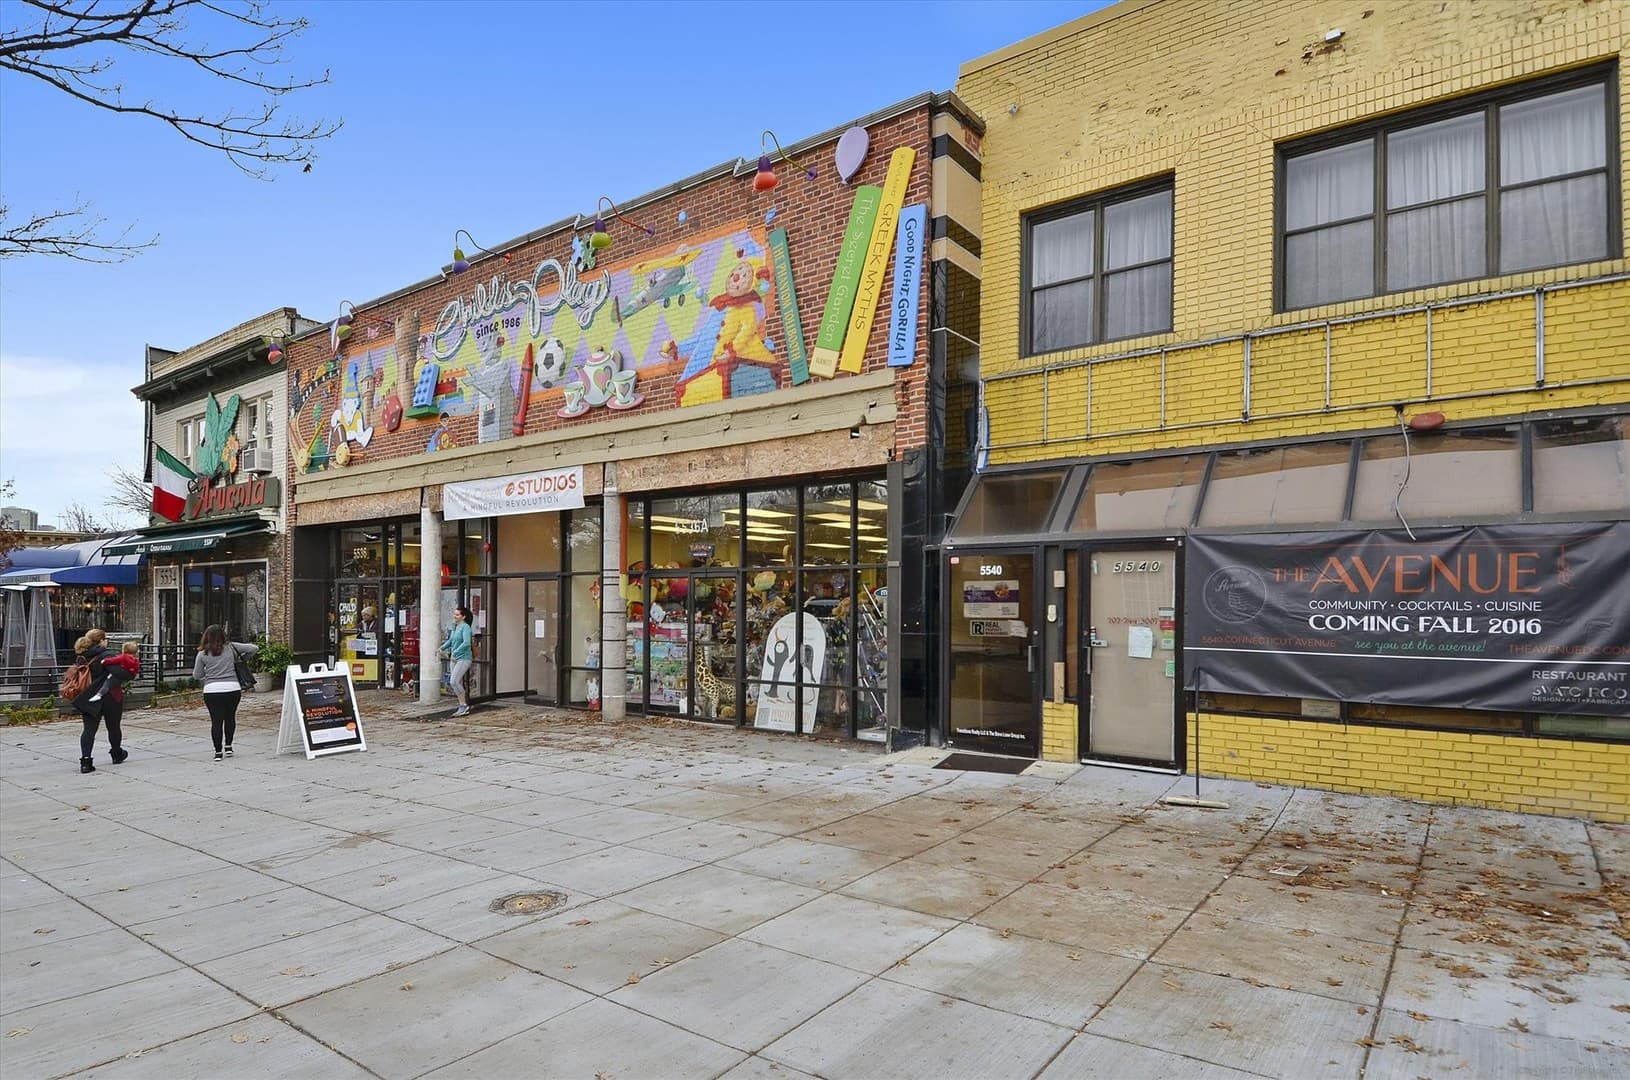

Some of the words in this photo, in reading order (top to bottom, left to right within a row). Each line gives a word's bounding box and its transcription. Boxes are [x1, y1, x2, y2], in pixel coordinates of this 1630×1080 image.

[856, 196, 872, 225] The
[870, 202, 894, 267] GREEK
[772, 243, 784, 260] THE
[841, 230, 863, 280] Secret
[775, 263, 792, 307] PHANTOM
[432, 272, 514, 359] Child's
[514, 258, 610, 337] Play
[855, 269, 877, 330] MYTHS
[824, 284, 848, 342] Garden
[476, 321, 499, 339] since
[501, 317, 521, 330] 1986
[783, 311, 801, 359] TOLLBOOTH
[518, 473, 577, 495] STUDIOS
[191, 474, 265, 519] Arucola
[470, 500, 503, 511] MINDFUL
[506, 495, 559, 507] REVOLUTION
[160, 569, 177, 584] 5534
[980, 565, 1002, 575] 5540
[1113, 561, 1160, 572] 5540
[1273, 568, 1310, 584] THE
[1310, 552, 1542, 594] AVENUE
[1309, 600, 1387, 610] COMMUNITY
[1398, 600, 1473, 611] COCKTAILS
[1485, 601, 1542, 611] CUISINE
[1308, 614, 1410, 633] COMING
[1418, 617, 1479, 634] FALL
[1488, 618, 1542, 635] 2016
[1224, 635, 1292, 646] CONNECTICUT
[1295, 639, 1337, 648] AVENUE
[1354, 641, 1372, 649] see
[1374, 641, 1399, 653] you
[1401, 639, 1415, 650] at
[1417, 639, 1436, 651] the
[1438, 639, 1487, 653] avenue!
[1532, 670, 1627, 682] RESTAURANT
